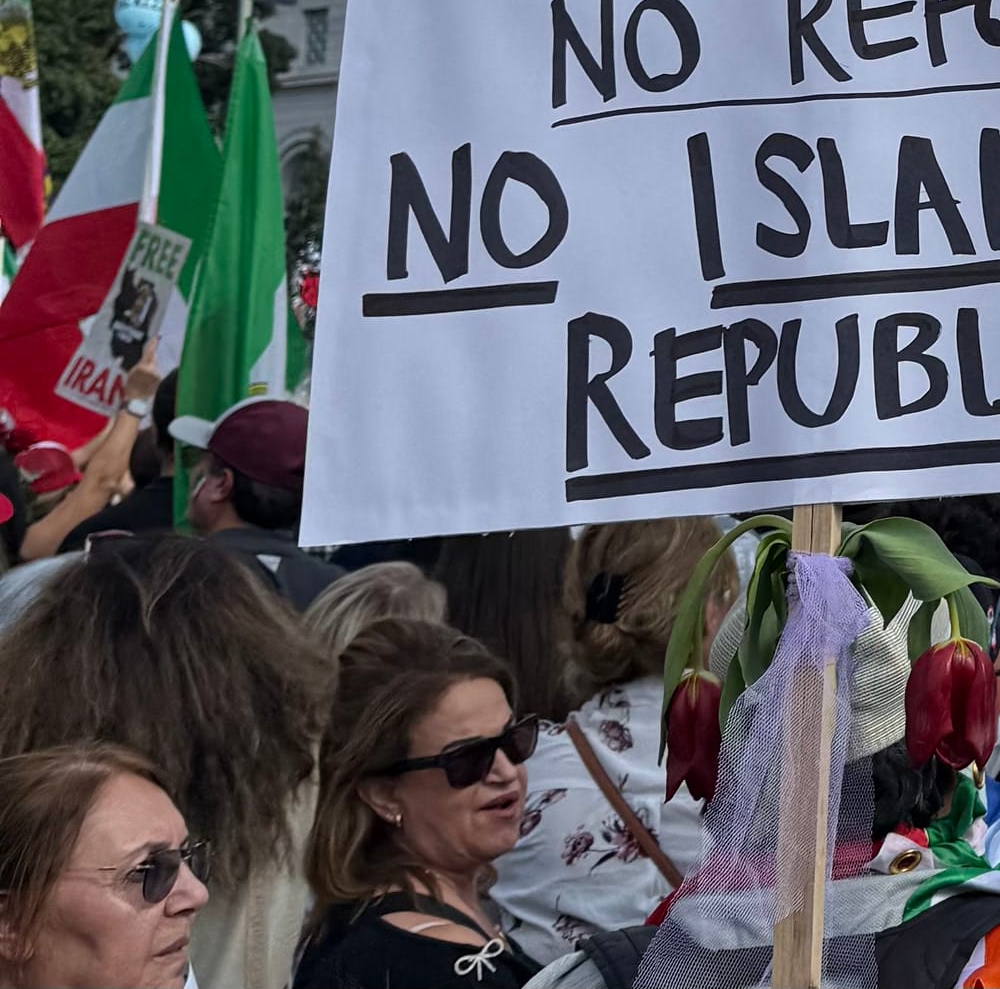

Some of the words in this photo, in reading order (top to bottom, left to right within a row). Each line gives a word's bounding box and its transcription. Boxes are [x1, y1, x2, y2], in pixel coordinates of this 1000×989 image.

[386, 142, 569, 285] NO
[129, 228, 184, 281] FREE
[63, 356, 126, 407] IRAN
